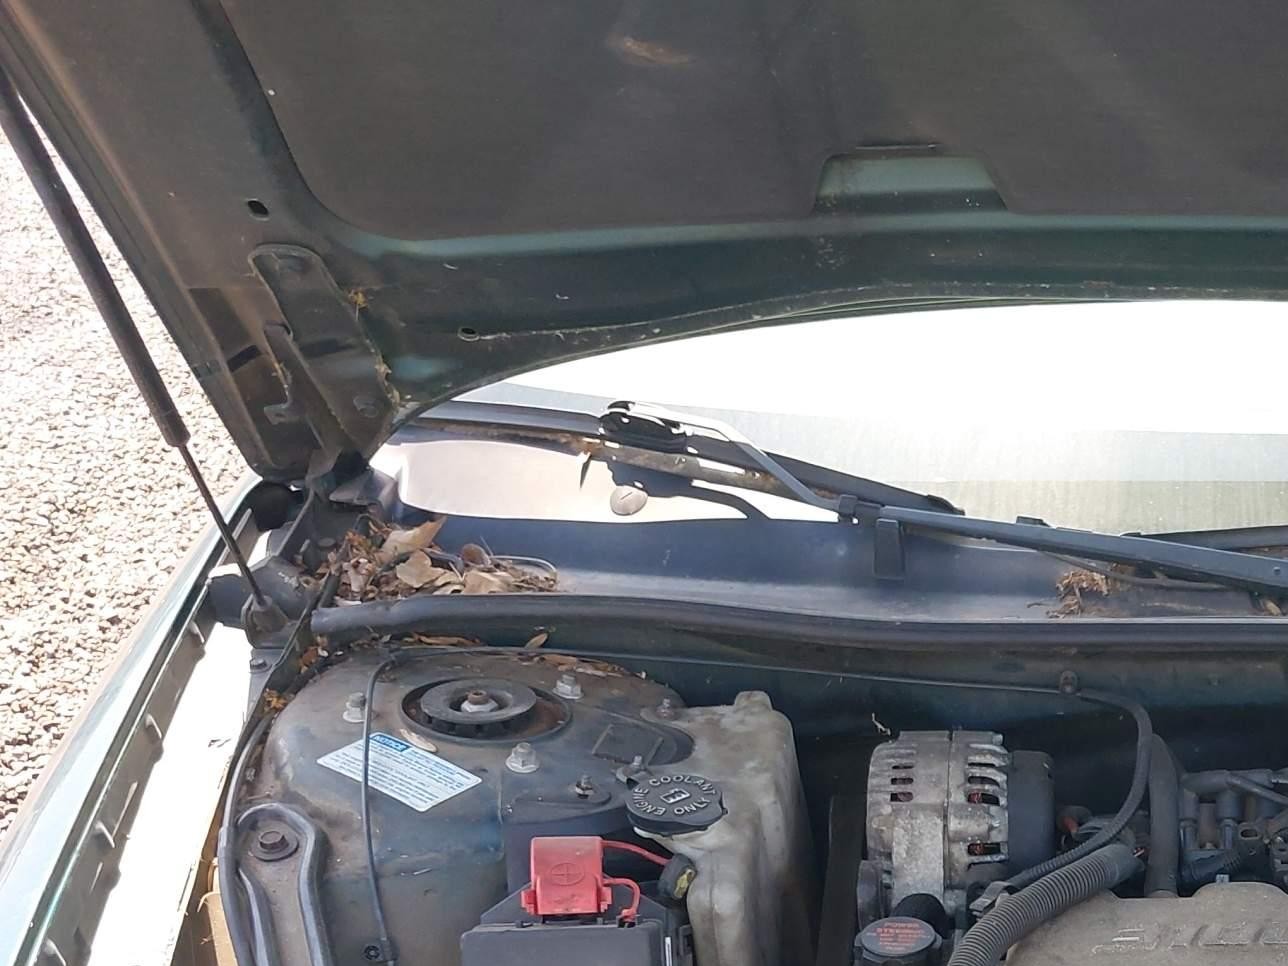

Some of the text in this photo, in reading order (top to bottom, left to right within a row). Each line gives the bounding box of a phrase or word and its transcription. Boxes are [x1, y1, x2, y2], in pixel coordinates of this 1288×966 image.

[633, 775, 716, 816] ENGINE COOLANT
[673, 797, 711, 815] ONLY
